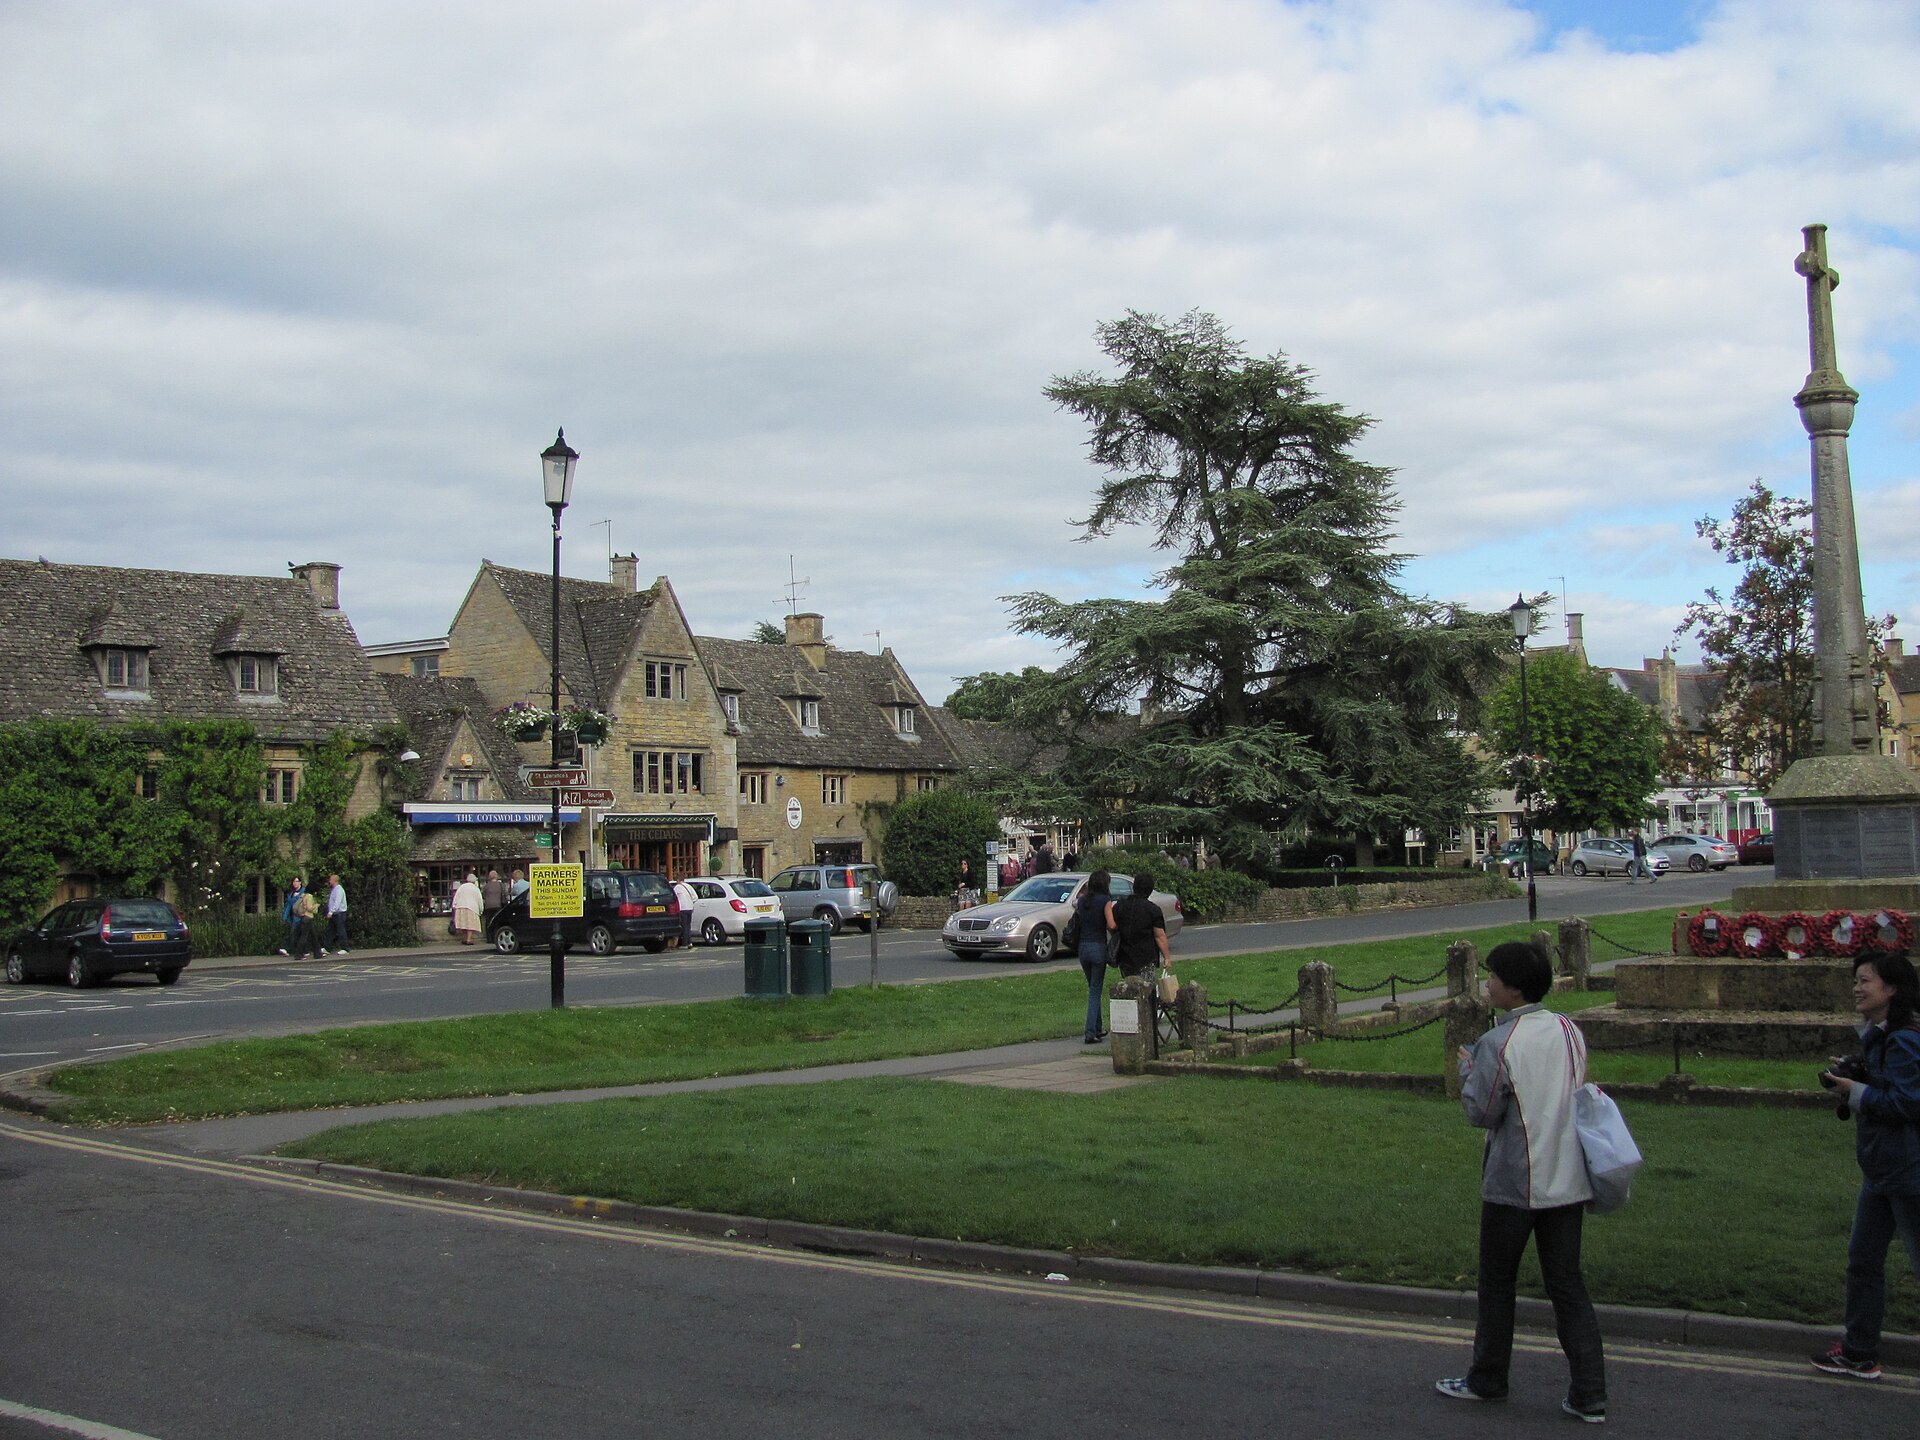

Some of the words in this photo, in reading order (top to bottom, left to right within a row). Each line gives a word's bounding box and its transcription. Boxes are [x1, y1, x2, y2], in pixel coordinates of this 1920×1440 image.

[456, 814, 474, 822] THE
[477, 814, 521, 822] COTSWOLD
[524, 814, 544, 822] SHOP
[628, 830, 646, 840] THE
[648, 829, 682, 839] CEDARS
[532, 870, 580, 879] FARMERS'
[536, 879, 577, 887] MARKET
